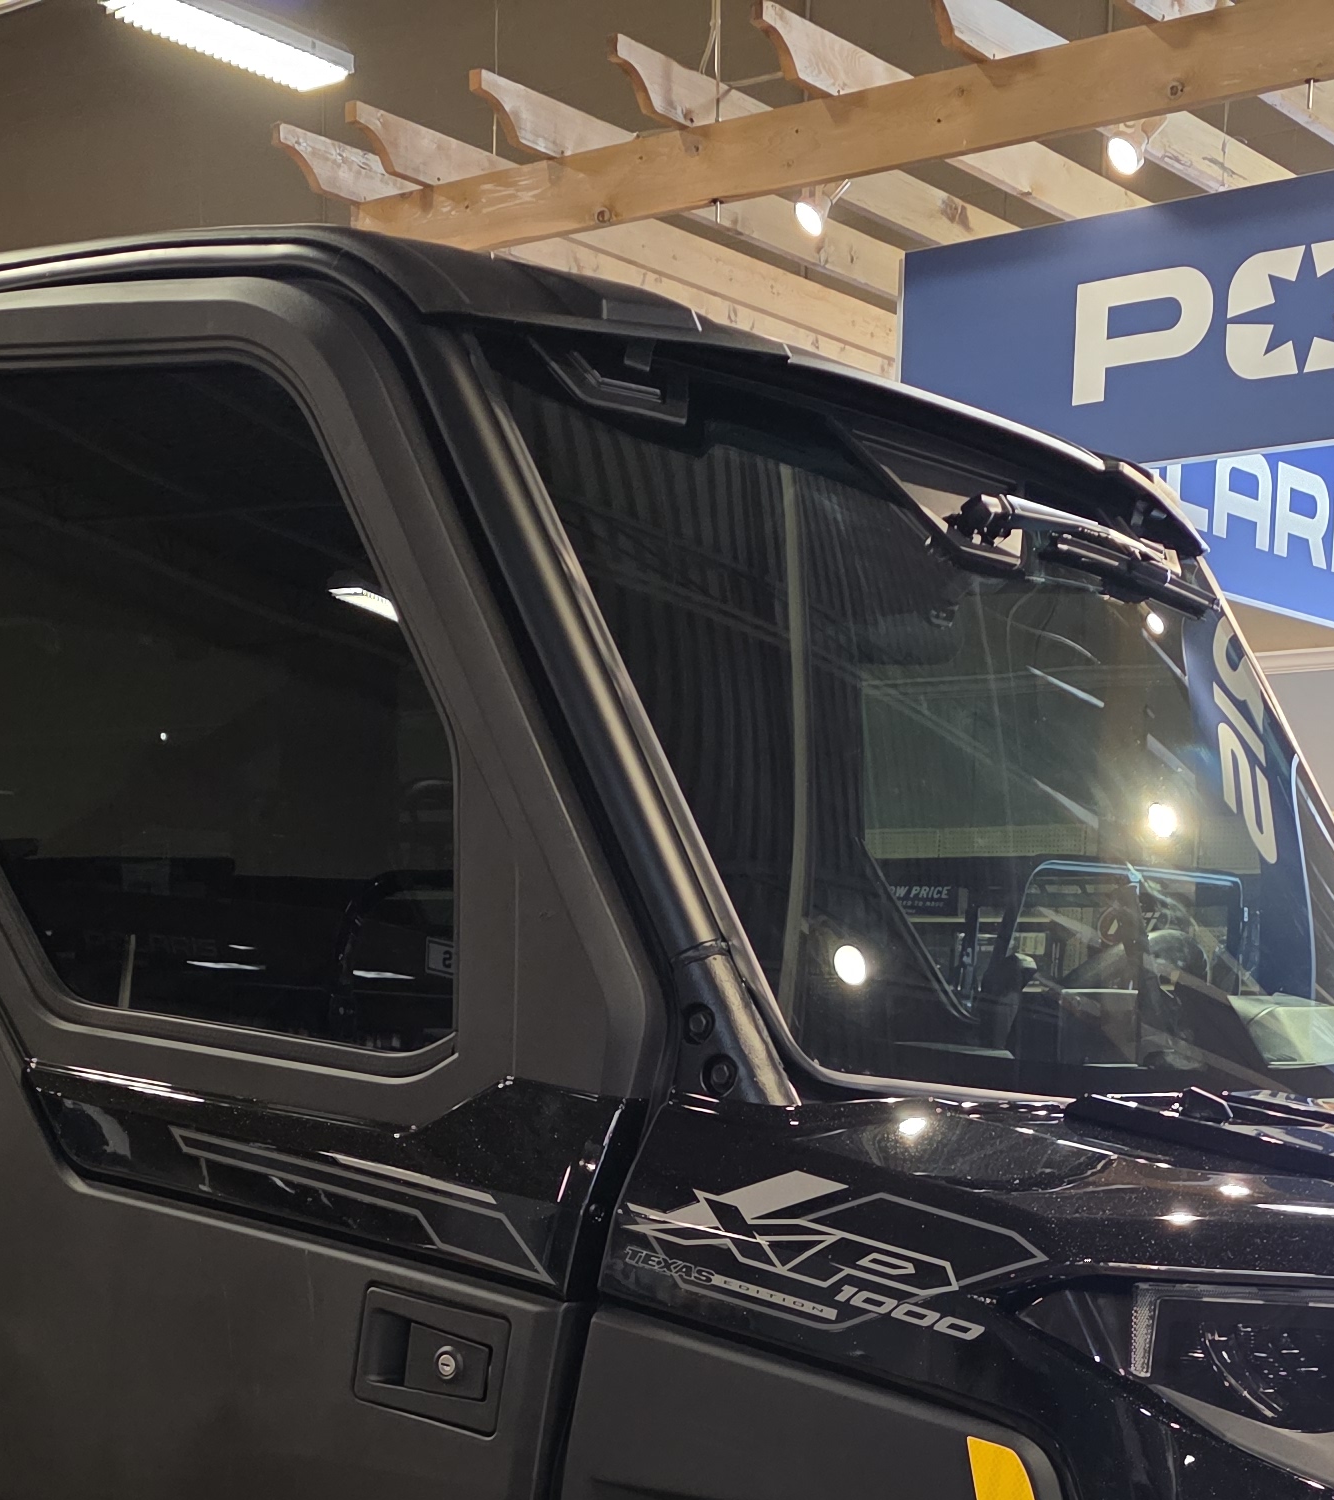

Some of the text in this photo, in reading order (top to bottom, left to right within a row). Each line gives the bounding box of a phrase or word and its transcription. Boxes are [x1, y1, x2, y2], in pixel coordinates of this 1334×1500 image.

[910, 886, 951, 898] PRICE
[625, 1246, 825, 1314] TEXAS EDITION
[833, 1284, 986, 1341] 1000
